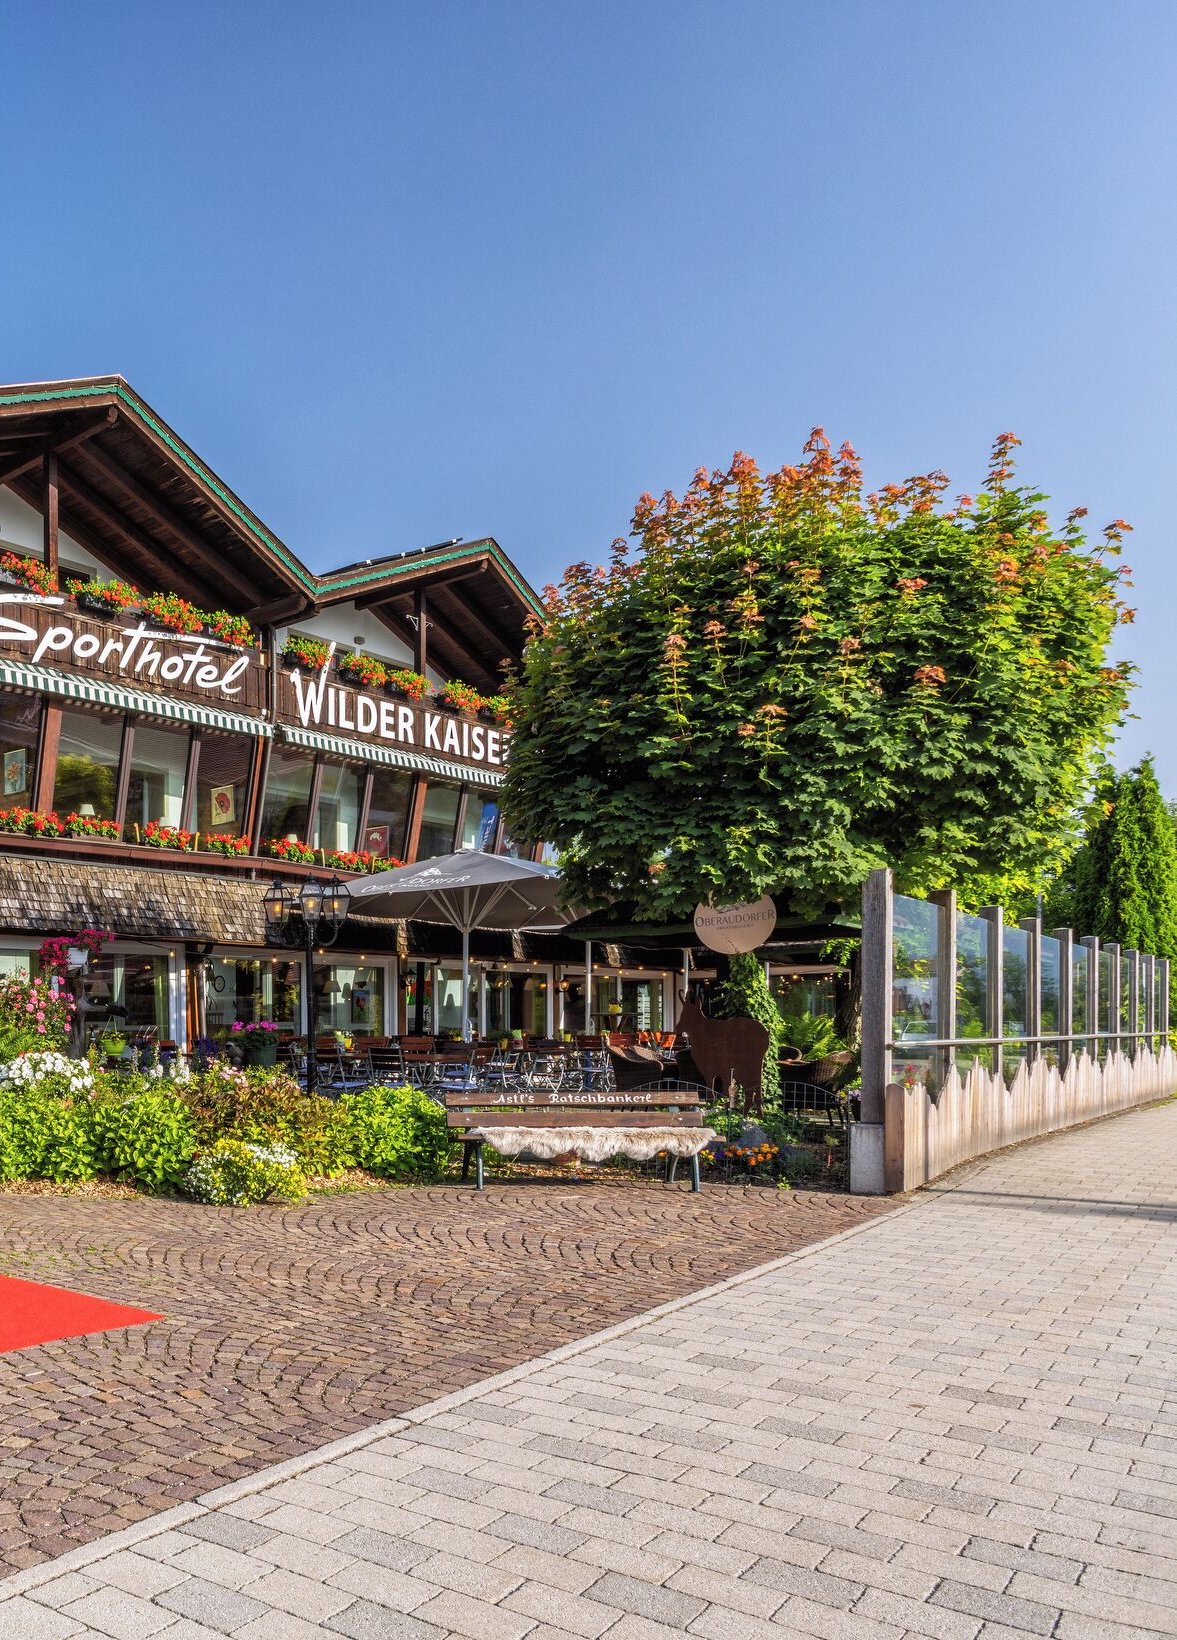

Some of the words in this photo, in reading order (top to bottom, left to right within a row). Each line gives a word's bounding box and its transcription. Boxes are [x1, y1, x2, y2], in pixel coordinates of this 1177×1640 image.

[290, 641, 415, 744] WILDER
[694, 909, 776, 928] OBERAUDORFER
[548, 1092, 653, 1104] Ratschbankerl
